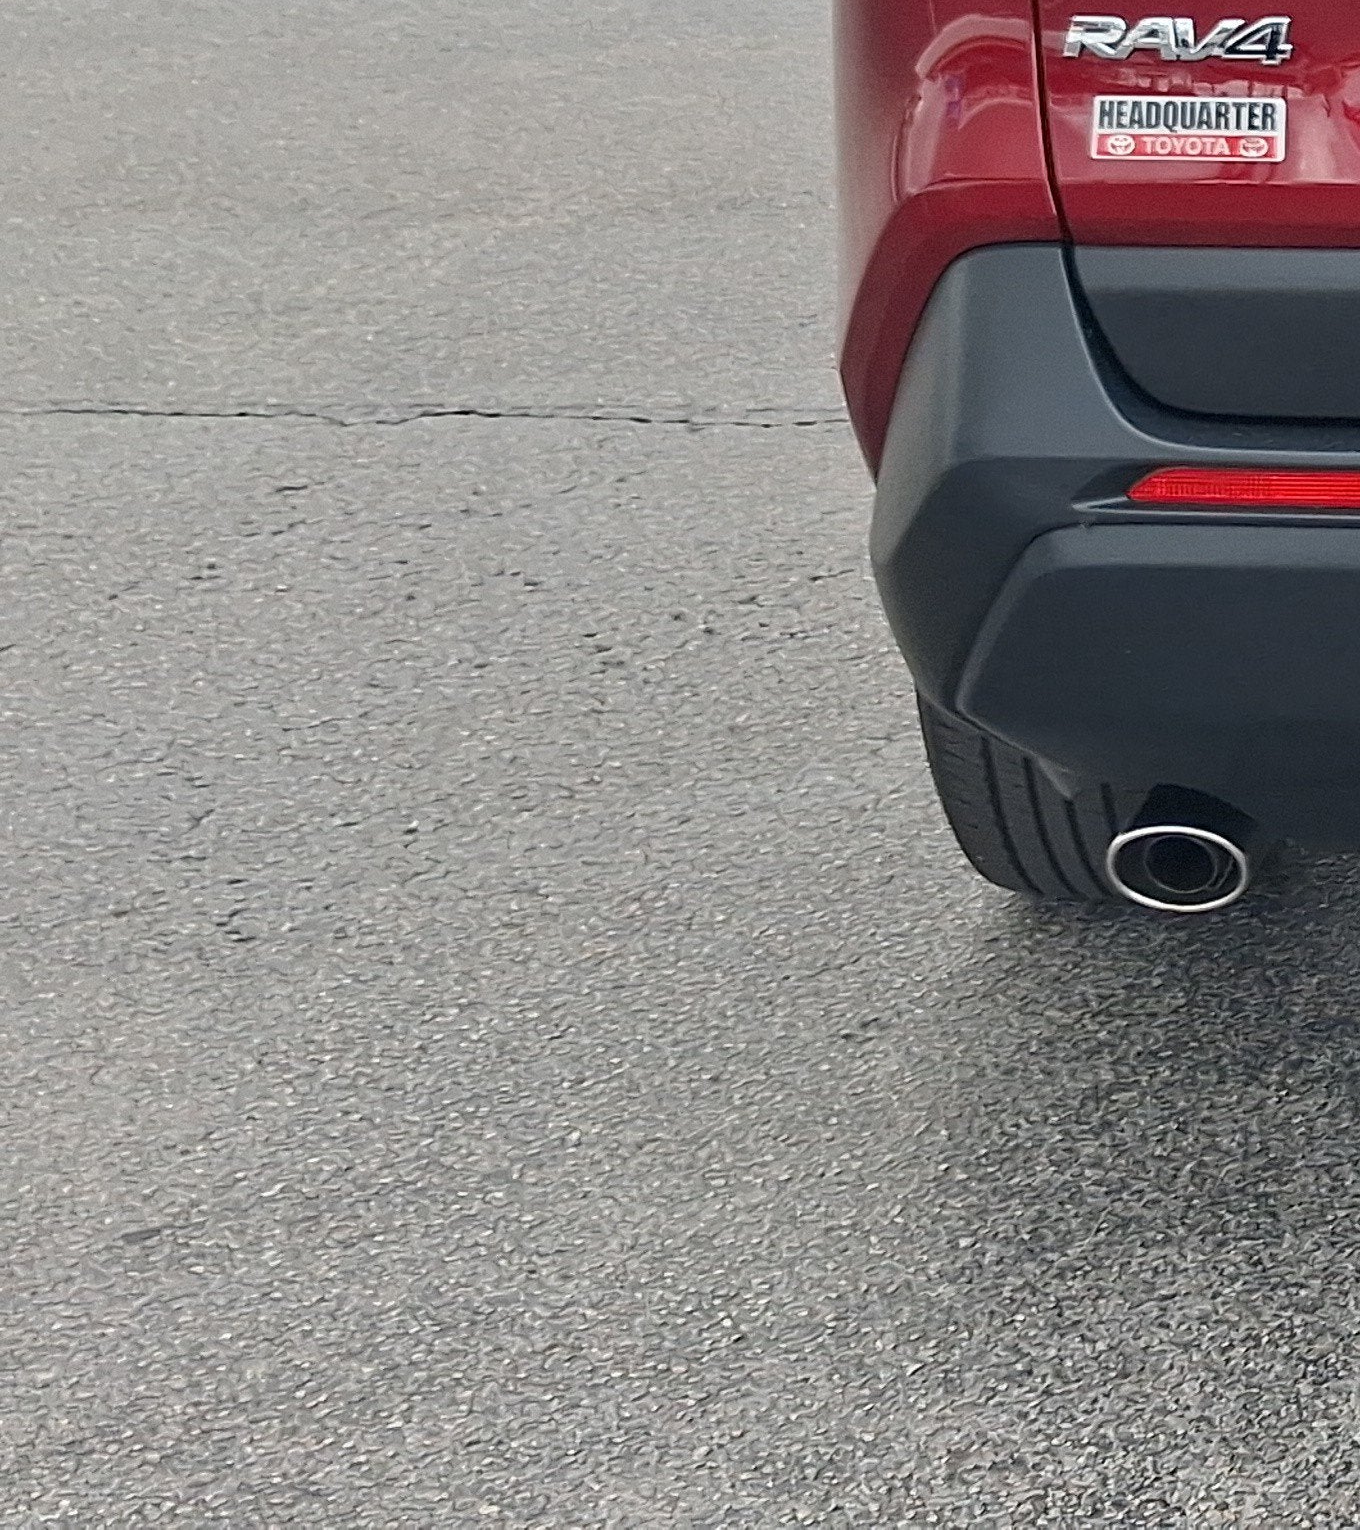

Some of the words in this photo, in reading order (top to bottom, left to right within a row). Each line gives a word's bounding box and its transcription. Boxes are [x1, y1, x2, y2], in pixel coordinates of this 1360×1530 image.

[1062, 15, 1294, 66] RAV4
[1099, 100, 1278, 133] HEADQUARTER
[1142, 137, 1232, 156] TOYOTA
